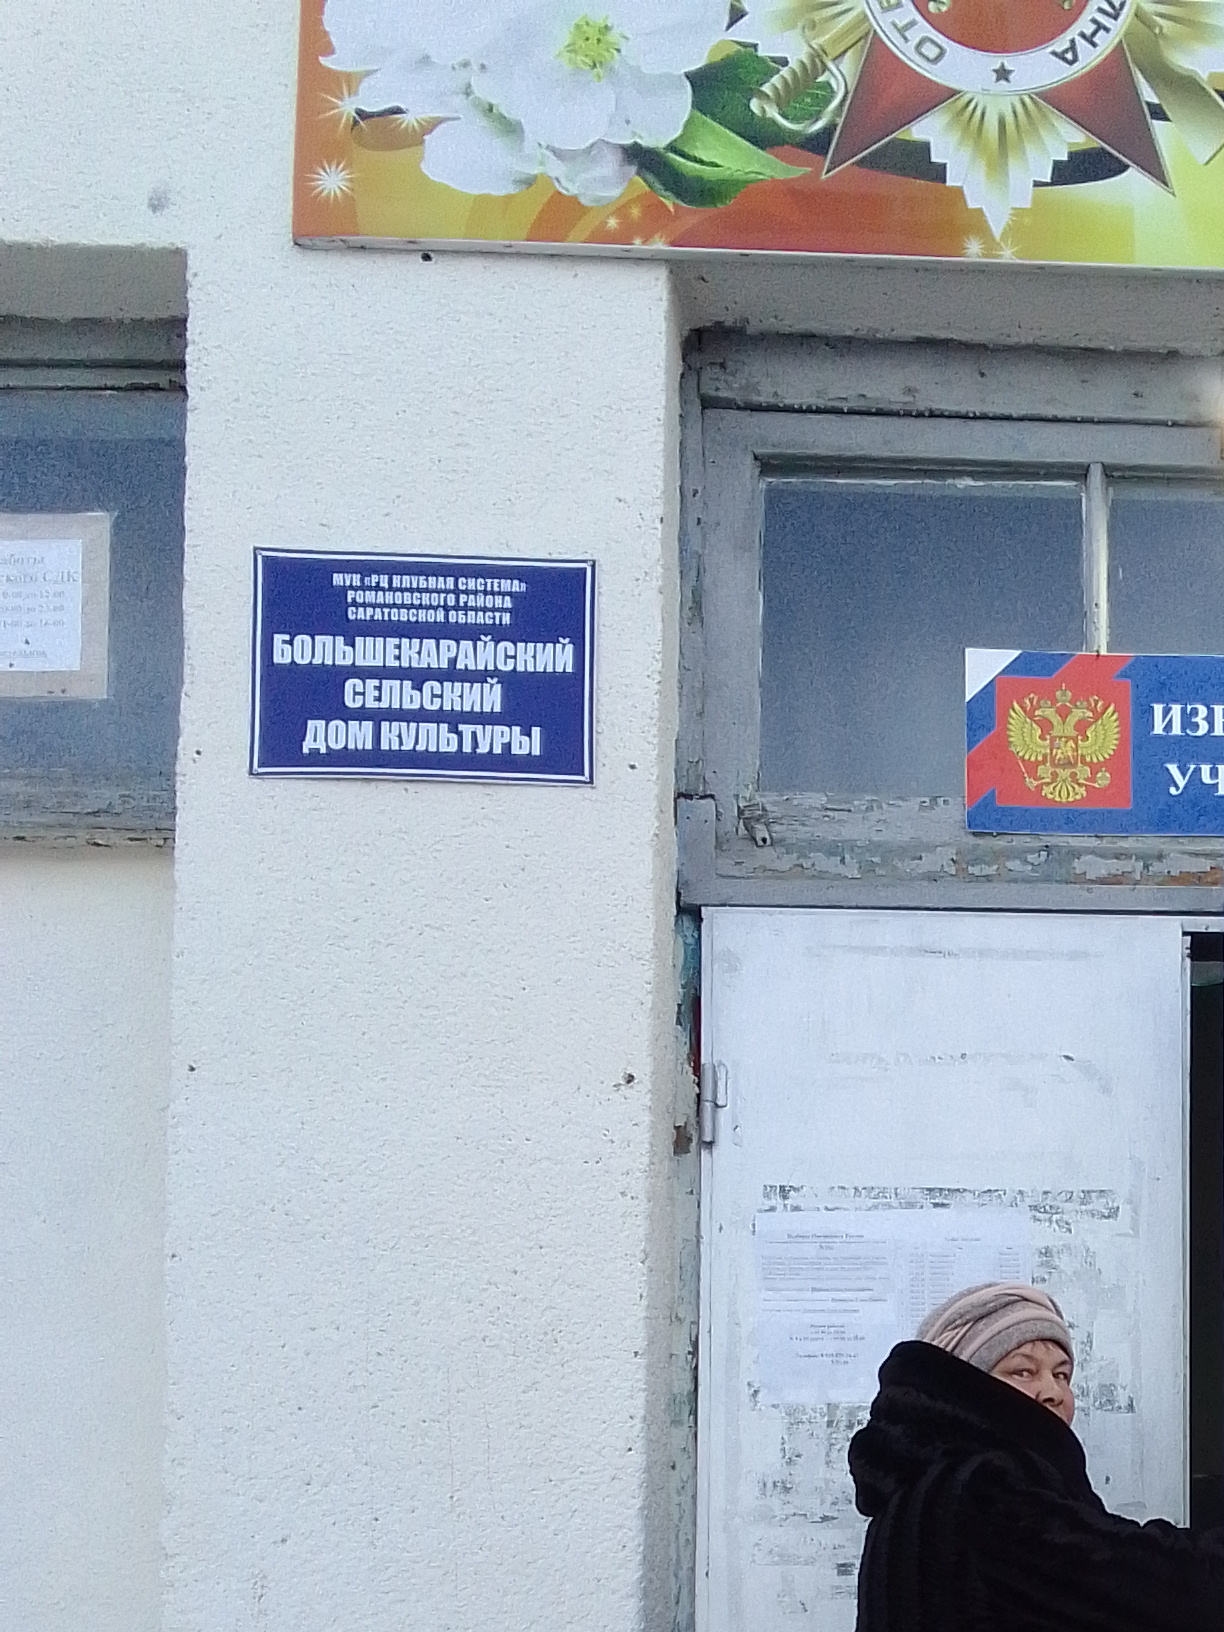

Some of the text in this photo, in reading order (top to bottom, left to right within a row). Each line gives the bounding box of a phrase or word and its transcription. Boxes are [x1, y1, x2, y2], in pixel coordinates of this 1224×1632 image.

[332, 573, 362, 587] МУК
[392, 575, 456, 590] КЛУБНАЯ
[347, 590, 513, 608] РОМАНОВСКОГО РАЙОНА
[347, 606, 511, 625] САРАТОВСКОЙ ОБЛАСТИ
[272, 633, 575, 673] БОЛЬШЕКАРАЙСКИЙ
[344, 676, 503, 713] СЕЛЬСКИЙ
[302, 719, 542, 756] ДОМ КУЛЬТУРЫ
